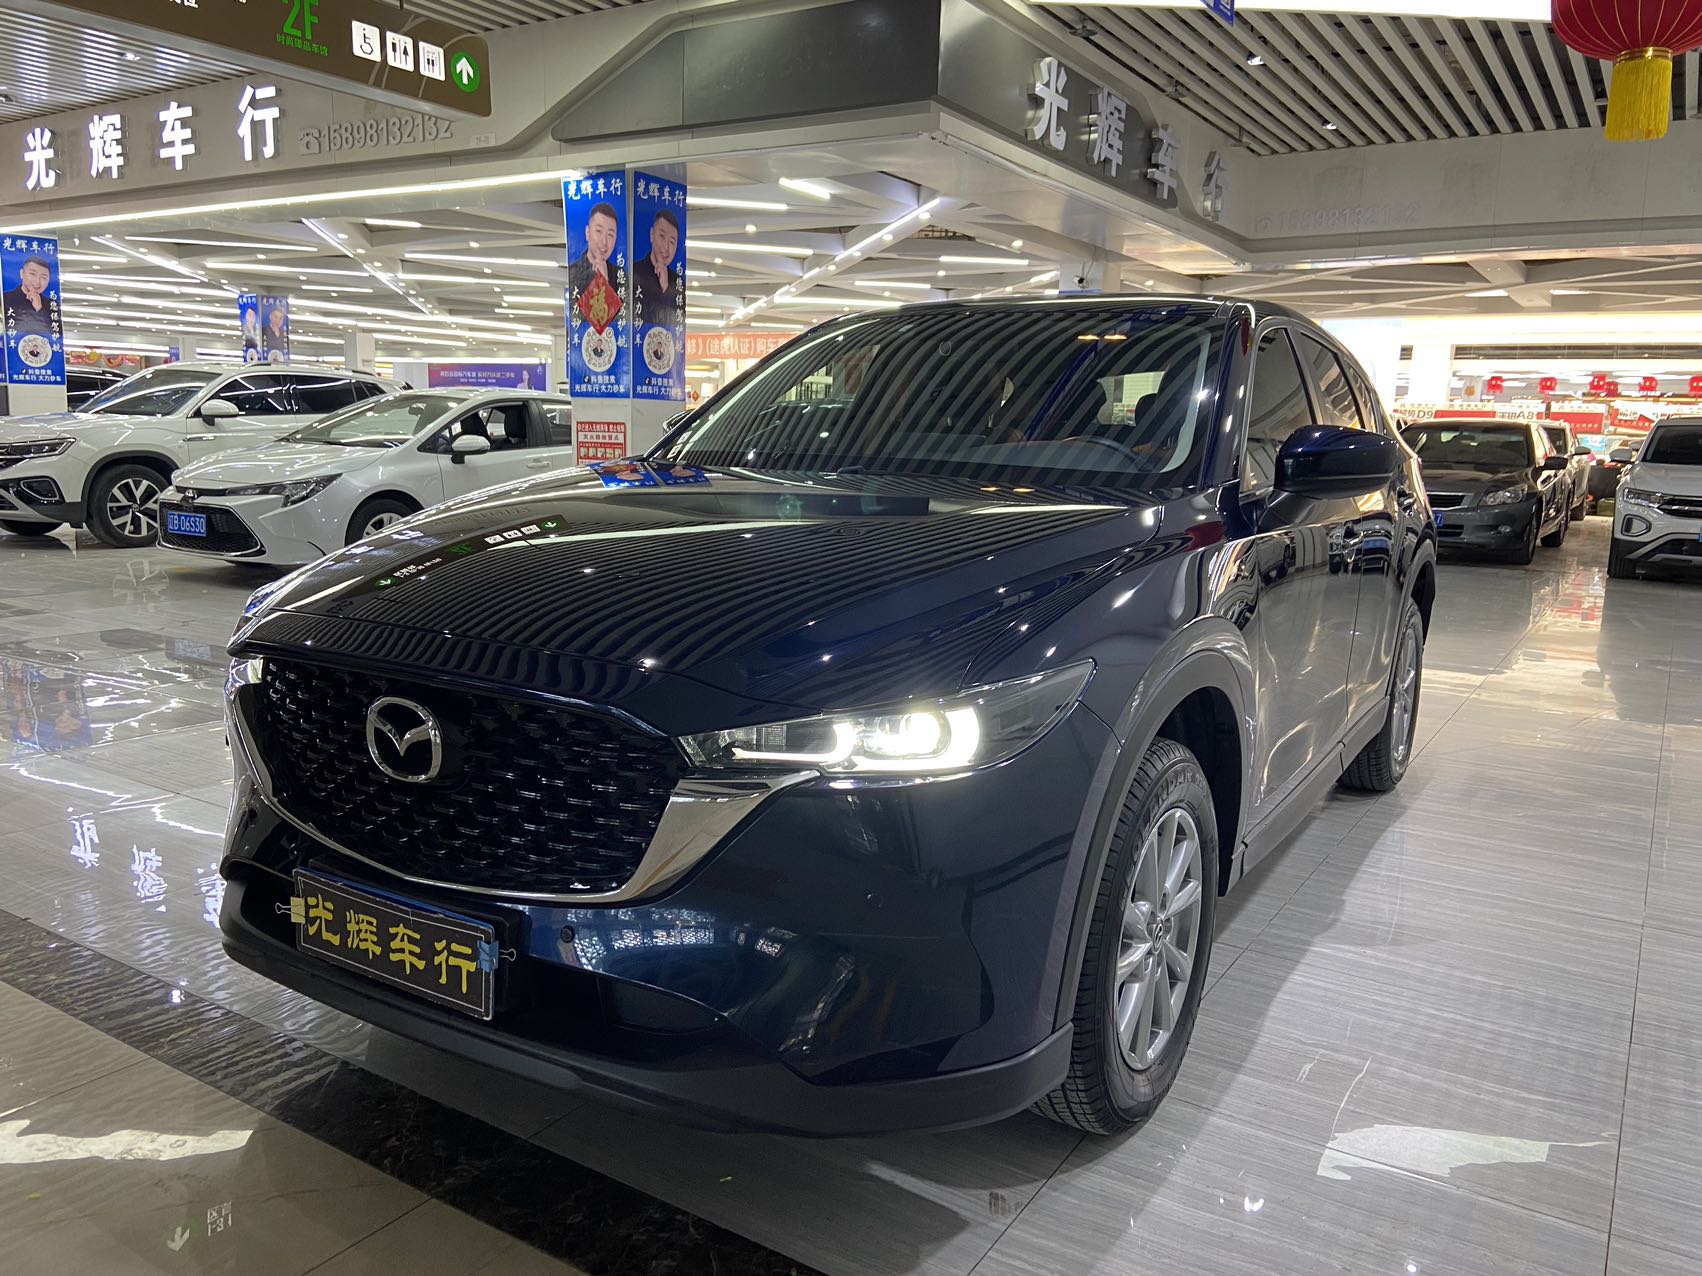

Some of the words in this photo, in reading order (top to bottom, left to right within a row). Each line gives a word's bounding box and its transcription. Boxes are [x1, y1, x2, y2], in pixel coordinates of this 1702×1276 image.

[281, 0, 319, 40] 2F
[23, 84, 280, 191] 光辉车行
[567, 178, 623, 201] 光辉车行
[636, 180, 685, 208] 光辉车行
[2, 238, 56, 255] 光辉车行
[675, 261, 684, 352] 为您保驾护航
[574, 384, 599, 393] 光辉车行
[306, 894, 477, 994] 光辉车行
